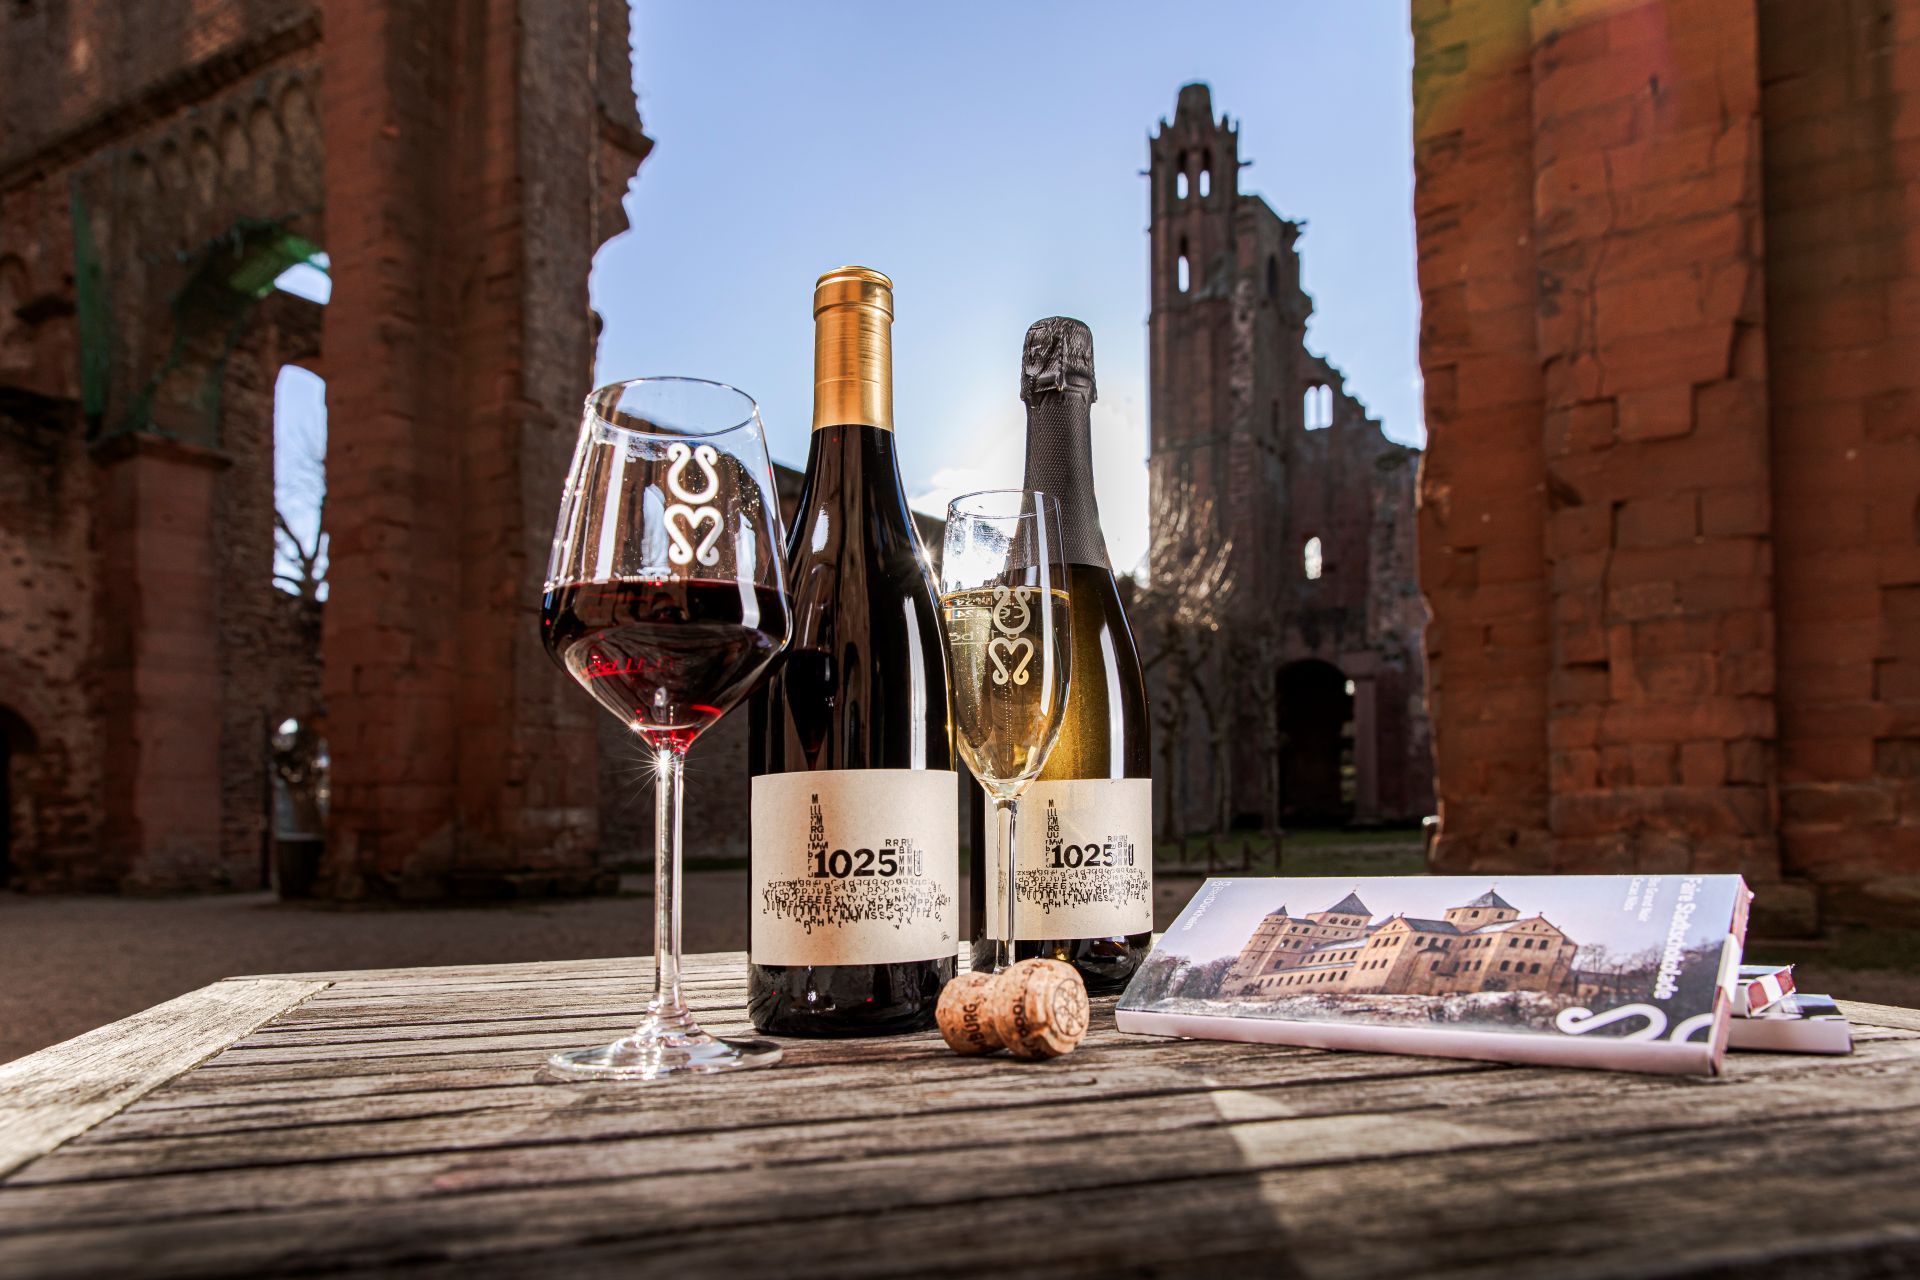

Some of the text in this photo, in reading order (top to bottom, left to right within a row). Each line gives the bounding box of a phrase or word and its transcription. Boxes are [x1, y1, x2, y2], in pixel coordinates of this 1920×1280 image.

[813, 848, 898, 879] 1025
[1051, 843, 1118, 869] 1025
[1653, 877, 1703, 999] Faire Stadtschokolade
